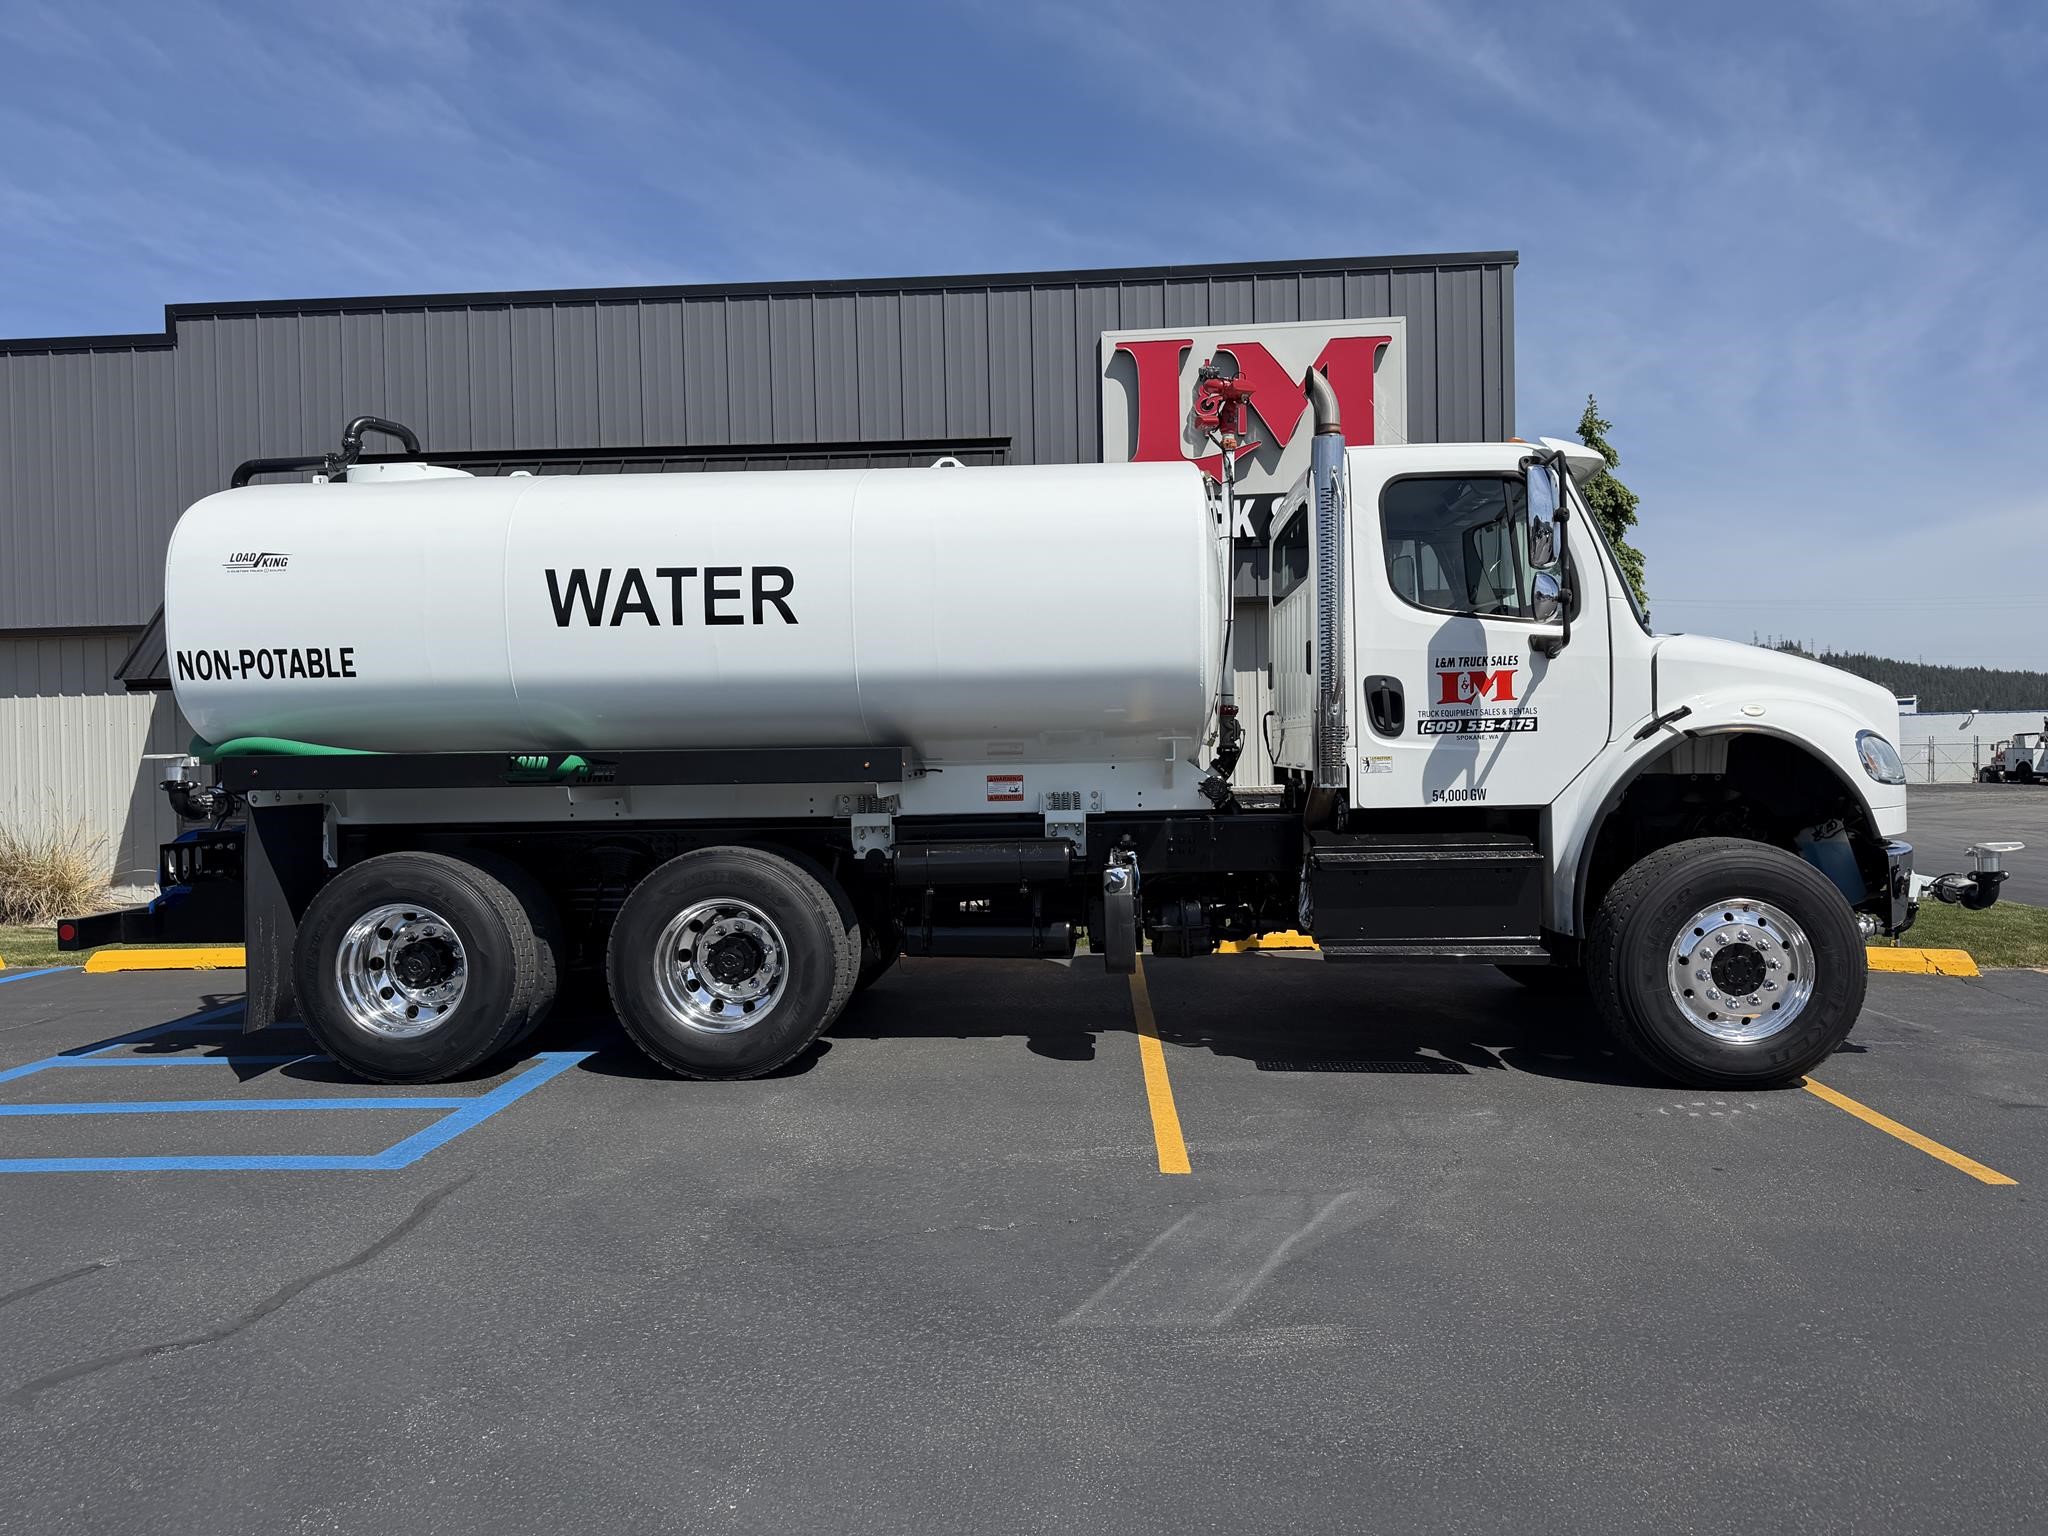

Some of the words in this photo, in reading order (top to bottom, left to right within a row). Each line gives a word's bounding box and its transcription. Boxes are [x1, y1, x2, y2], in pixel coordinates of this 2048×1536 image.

[230, 552, 257, 563] LOAD
[261, 557, 289, 568] KING
[544, 566, 799, 627] WATER
[176, 647, 357, 681] NON-POTABLE
[1435, 657, 1456, 668] L&M
[1459, 656, 1488, 667] TRUCK
[1491, 655, 1519, 666] SALES
[1436, 669, 1519, 705] L&M
[1418, 710, 1440, 718] TRUCK
[1441, 708, 1478, 718] EQUIPMENT
[1480, 708, 1500, 716] SALES
[1509, 707, 1538, 715] RENTALS
[1420, 720, 1463, 734] (509)
[1467, 719, 1535, 732] 535-4175
[1432, 789, 1468, 803] 54,000
[1470, 788, 1487, 801] GW
